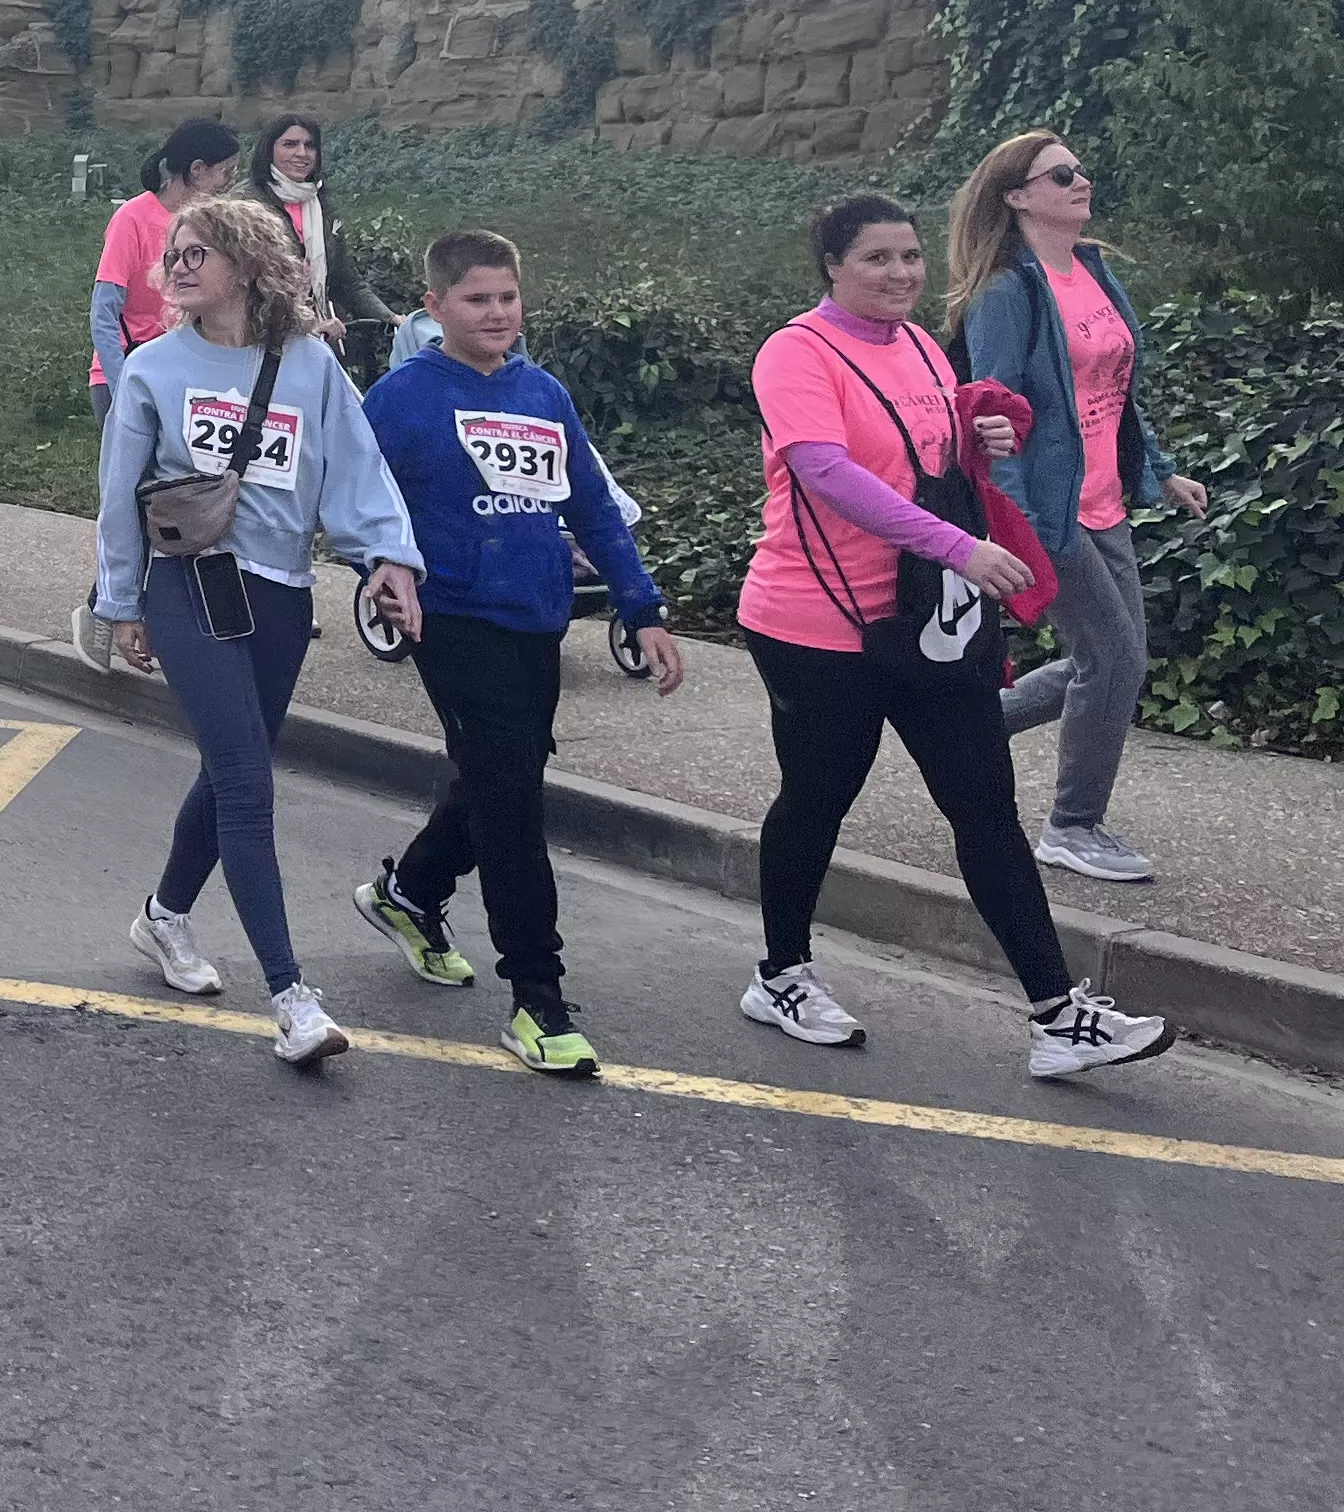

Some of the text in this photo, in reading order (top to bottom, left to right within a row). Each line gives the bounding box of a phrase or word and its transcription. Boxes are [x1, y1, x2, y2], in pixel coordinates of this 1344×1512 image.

[196, 405, 238, 422] CONTRA
[470, 439, 555, 482] 2931
[472, 495, 553, 516] adida
